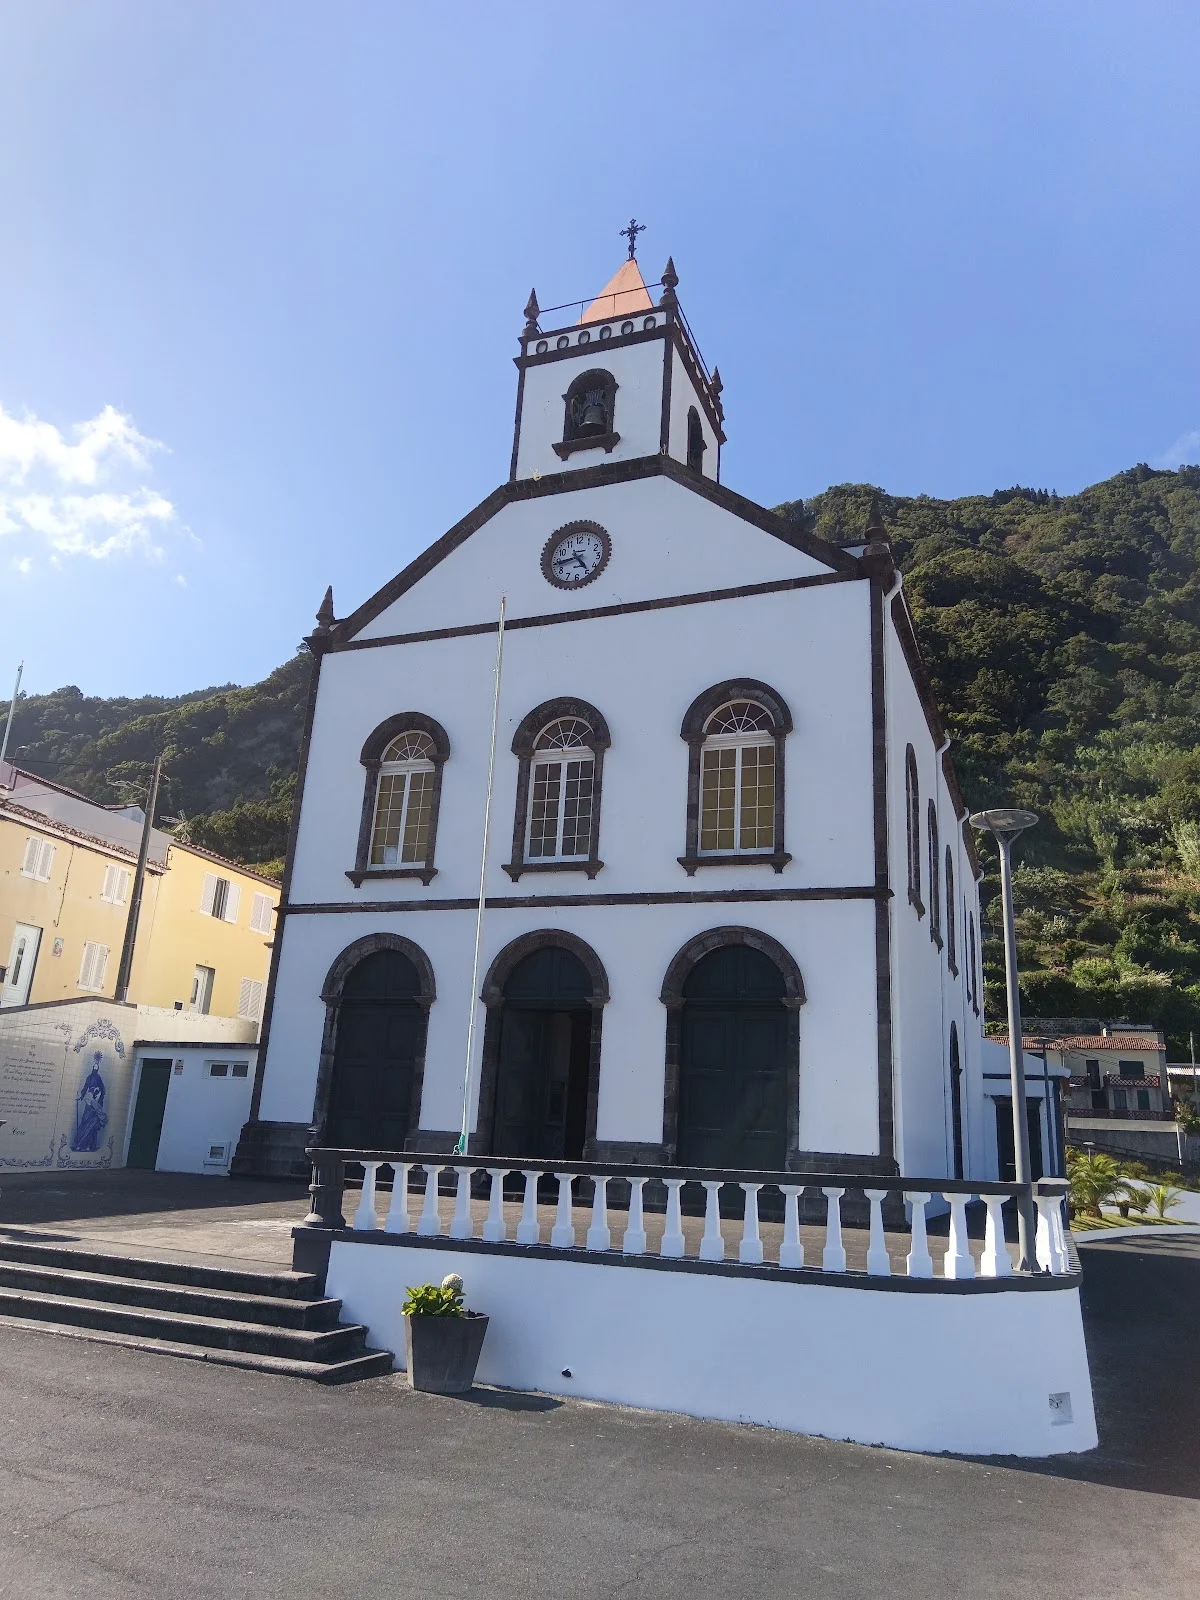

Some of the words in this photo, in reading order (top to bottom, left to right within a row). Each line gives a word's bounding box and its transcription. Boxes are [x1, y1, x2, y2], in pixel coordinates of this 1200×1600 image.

[576, 536, 584, 544] 12
[559, 548, 566, 556] 10
[593, 544, 598, 552] 2
[596, 552, 601, 560] 3
